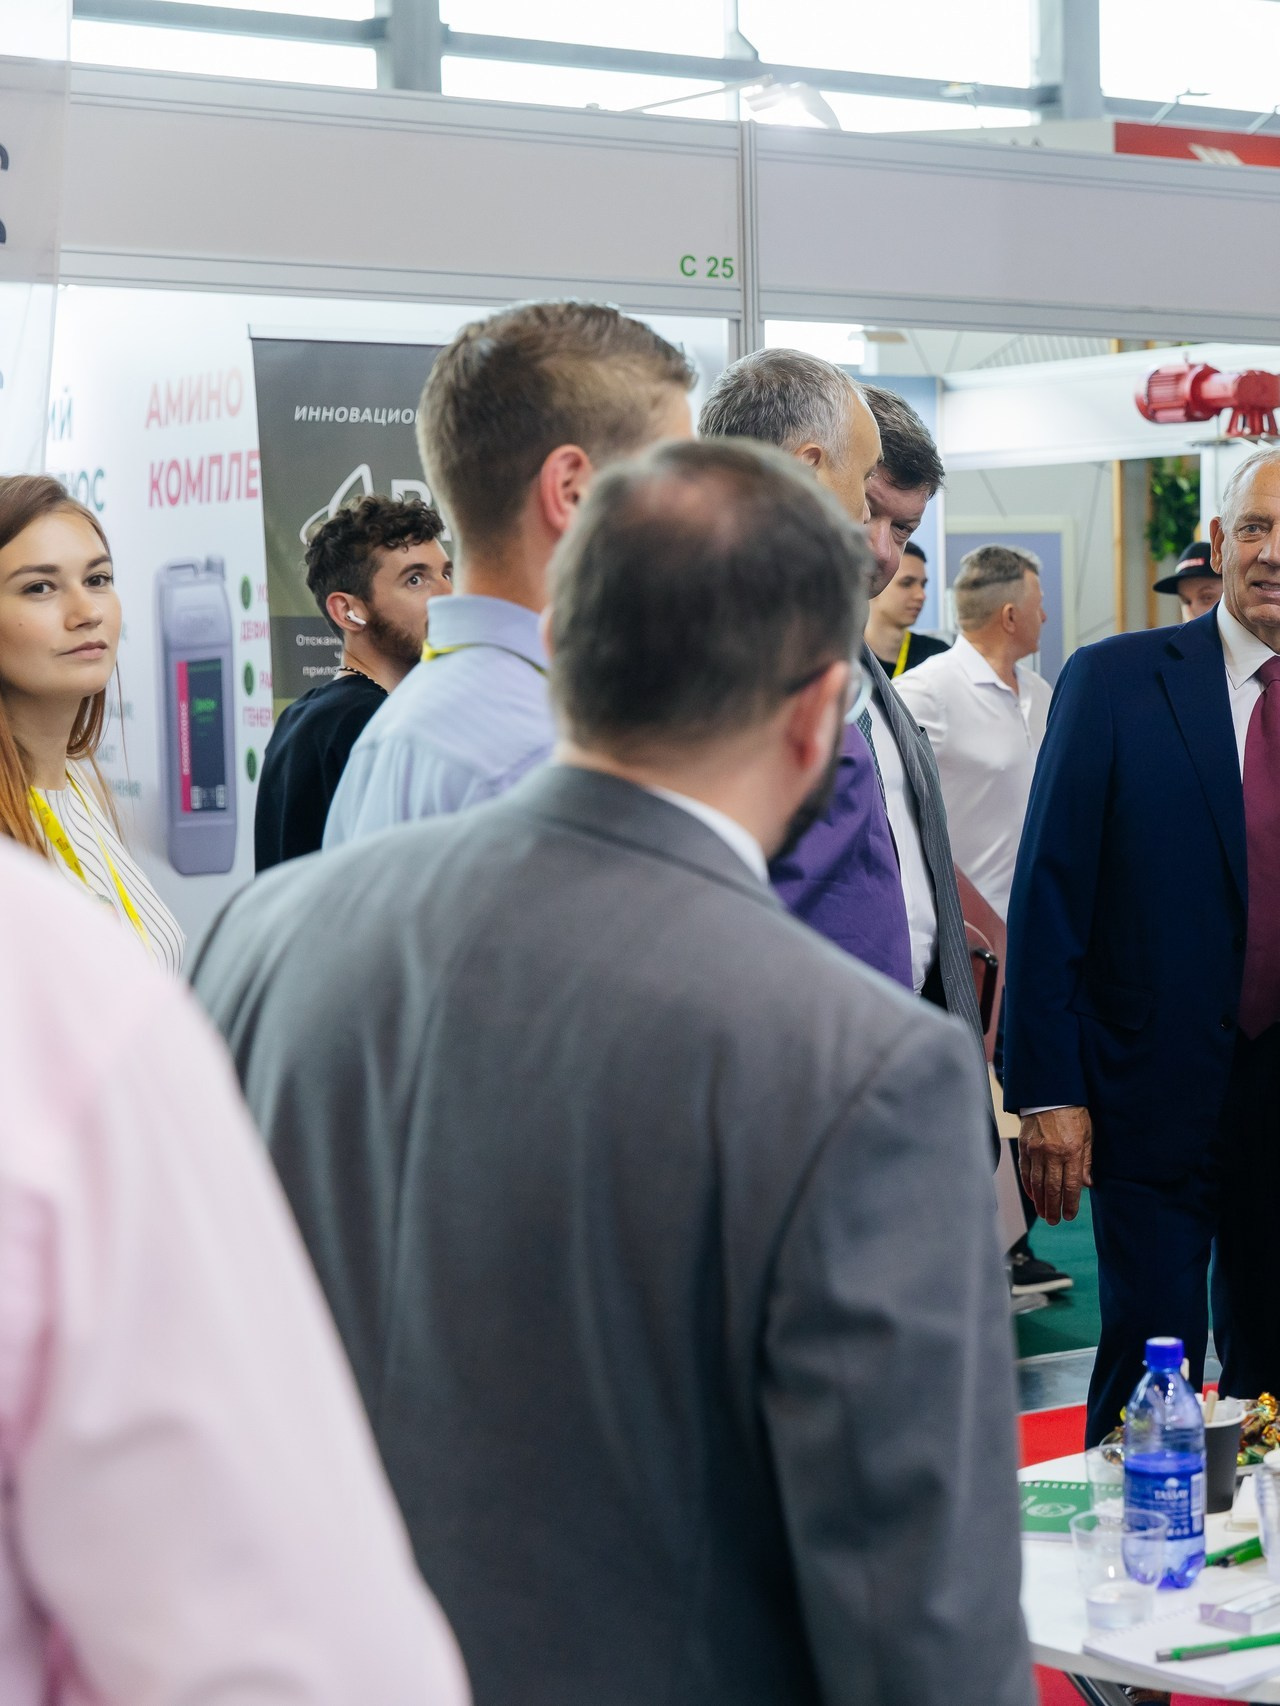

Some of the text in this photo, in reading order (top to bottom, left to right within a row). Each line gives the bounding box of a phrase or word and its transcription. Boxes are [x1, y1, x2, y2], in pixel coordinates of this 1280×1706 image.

[706, 255, 734, 279] 25
[145, 366, 243, 430] АМИНО
[294, 404, 420, 427] ИННОВАЦИО
[149, 449, 261, 509] КОМПЛЕ
